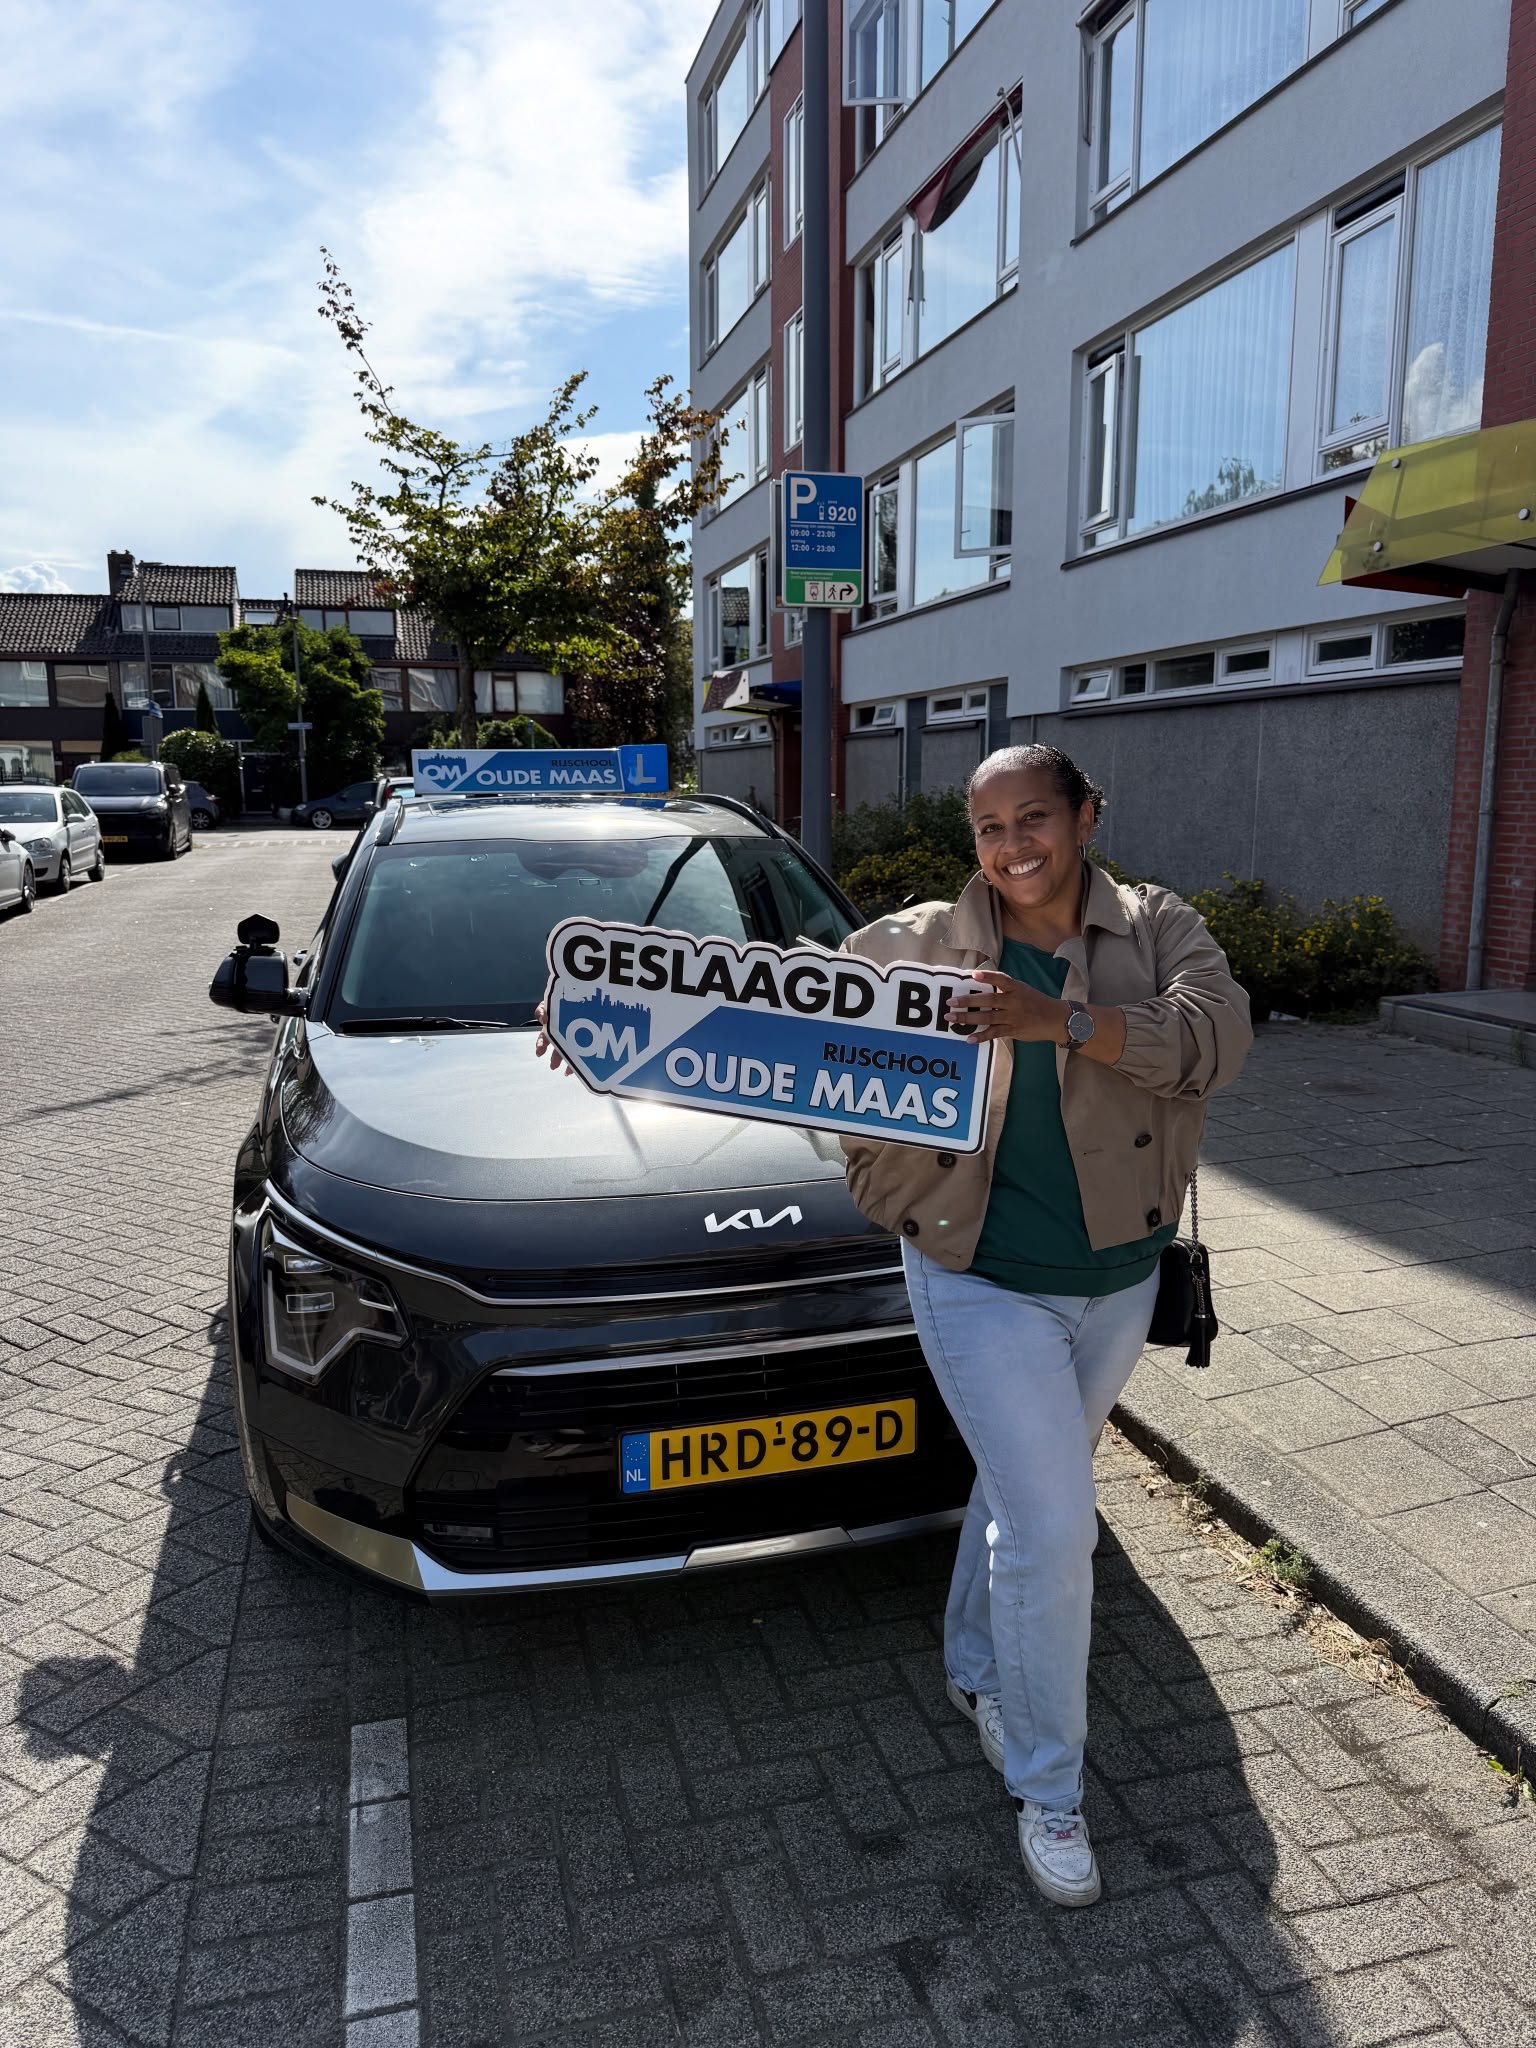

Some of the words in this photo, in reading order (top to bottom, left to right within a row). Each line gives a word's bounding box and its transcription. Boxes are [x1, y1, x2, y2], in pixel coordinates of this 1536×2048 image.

[790, 477, 817, 520] P
[828, 505, 857, 522] 920
[790, 529, 810, 537] 09:00
[816, 530, 836, 538] 23:00
[791, 544, 810, 552] 12:00
[816, 545, 836, 553] 23:00
[422, 764, 461, 781] OM
[551, 759, 614, 767] RIJSCHOOL
[636, 753, 656, 784] L
[475, 769, 542, 786] OUDE
[549, 769, 617, 785] MAAS
[562, 934, 875, 1020] GESLAAGD
[565, 1017, 638, 1063] OM
[823, 1042, 962, 1081] RIJSCHOOL
[664, 1047, 797, 1103] OUDE
[809, 1068, 959, 1128] MAAS
[704, 1205, 803, 1233] KIA
[626, 1468, 647, 1483] NL
